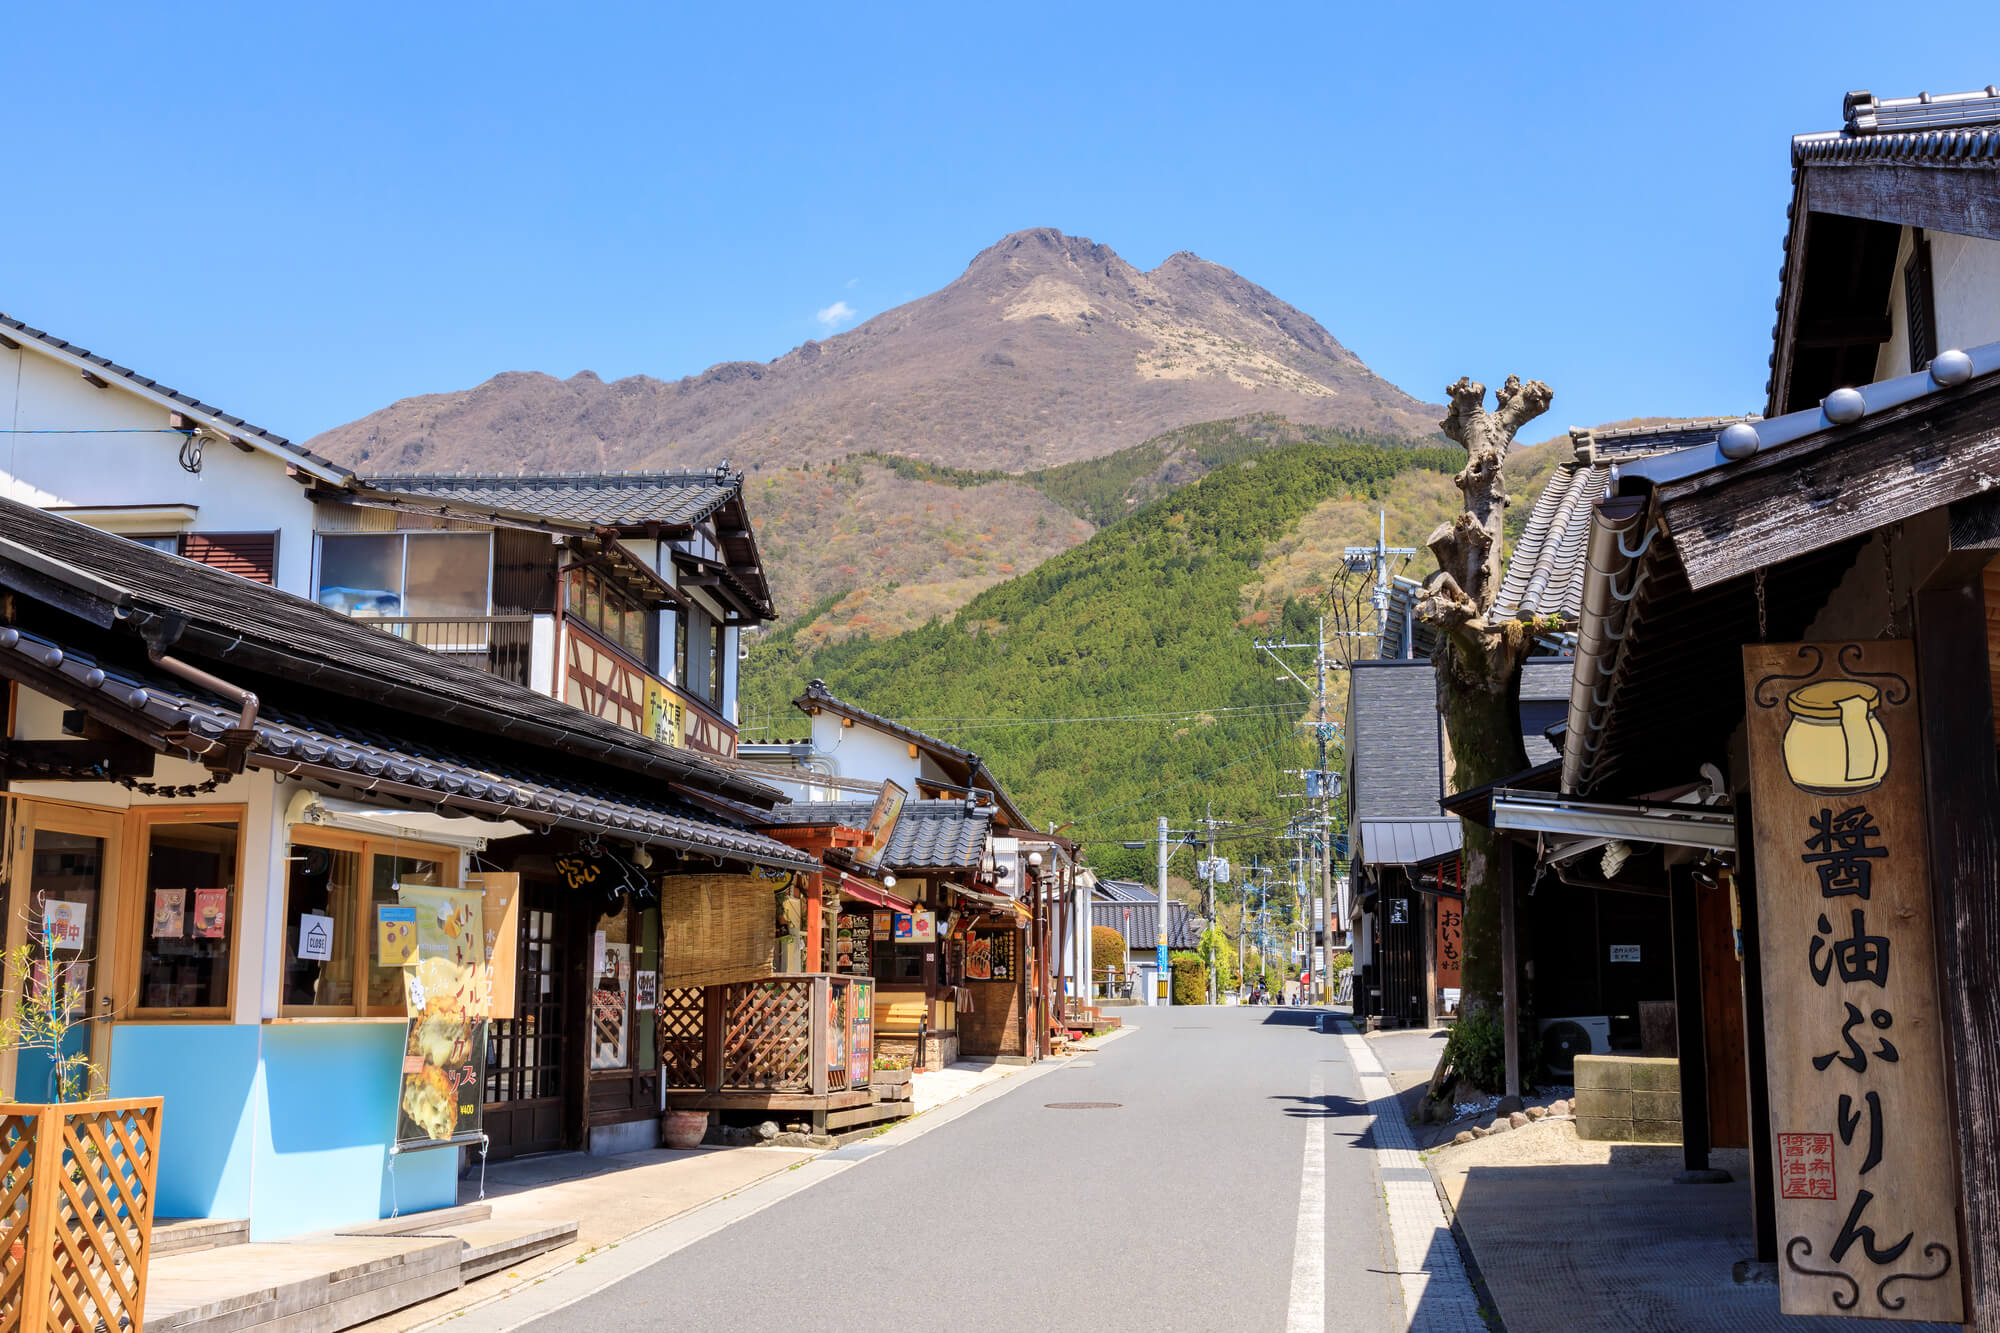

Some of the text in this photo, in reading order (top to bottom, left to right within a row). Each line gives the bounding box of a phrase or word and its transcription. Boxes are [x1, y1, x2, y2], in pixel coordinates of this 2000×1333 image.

[309, 936, 325, 949] CLOSE
[1441, 909, 1460, 960] おいも
[1801, 806, 1913, 1264] 醤油ぷりん
[460, 1104, 474, 1115] ¥400
[1806, 1135, 1833, 1196] 湯布院
